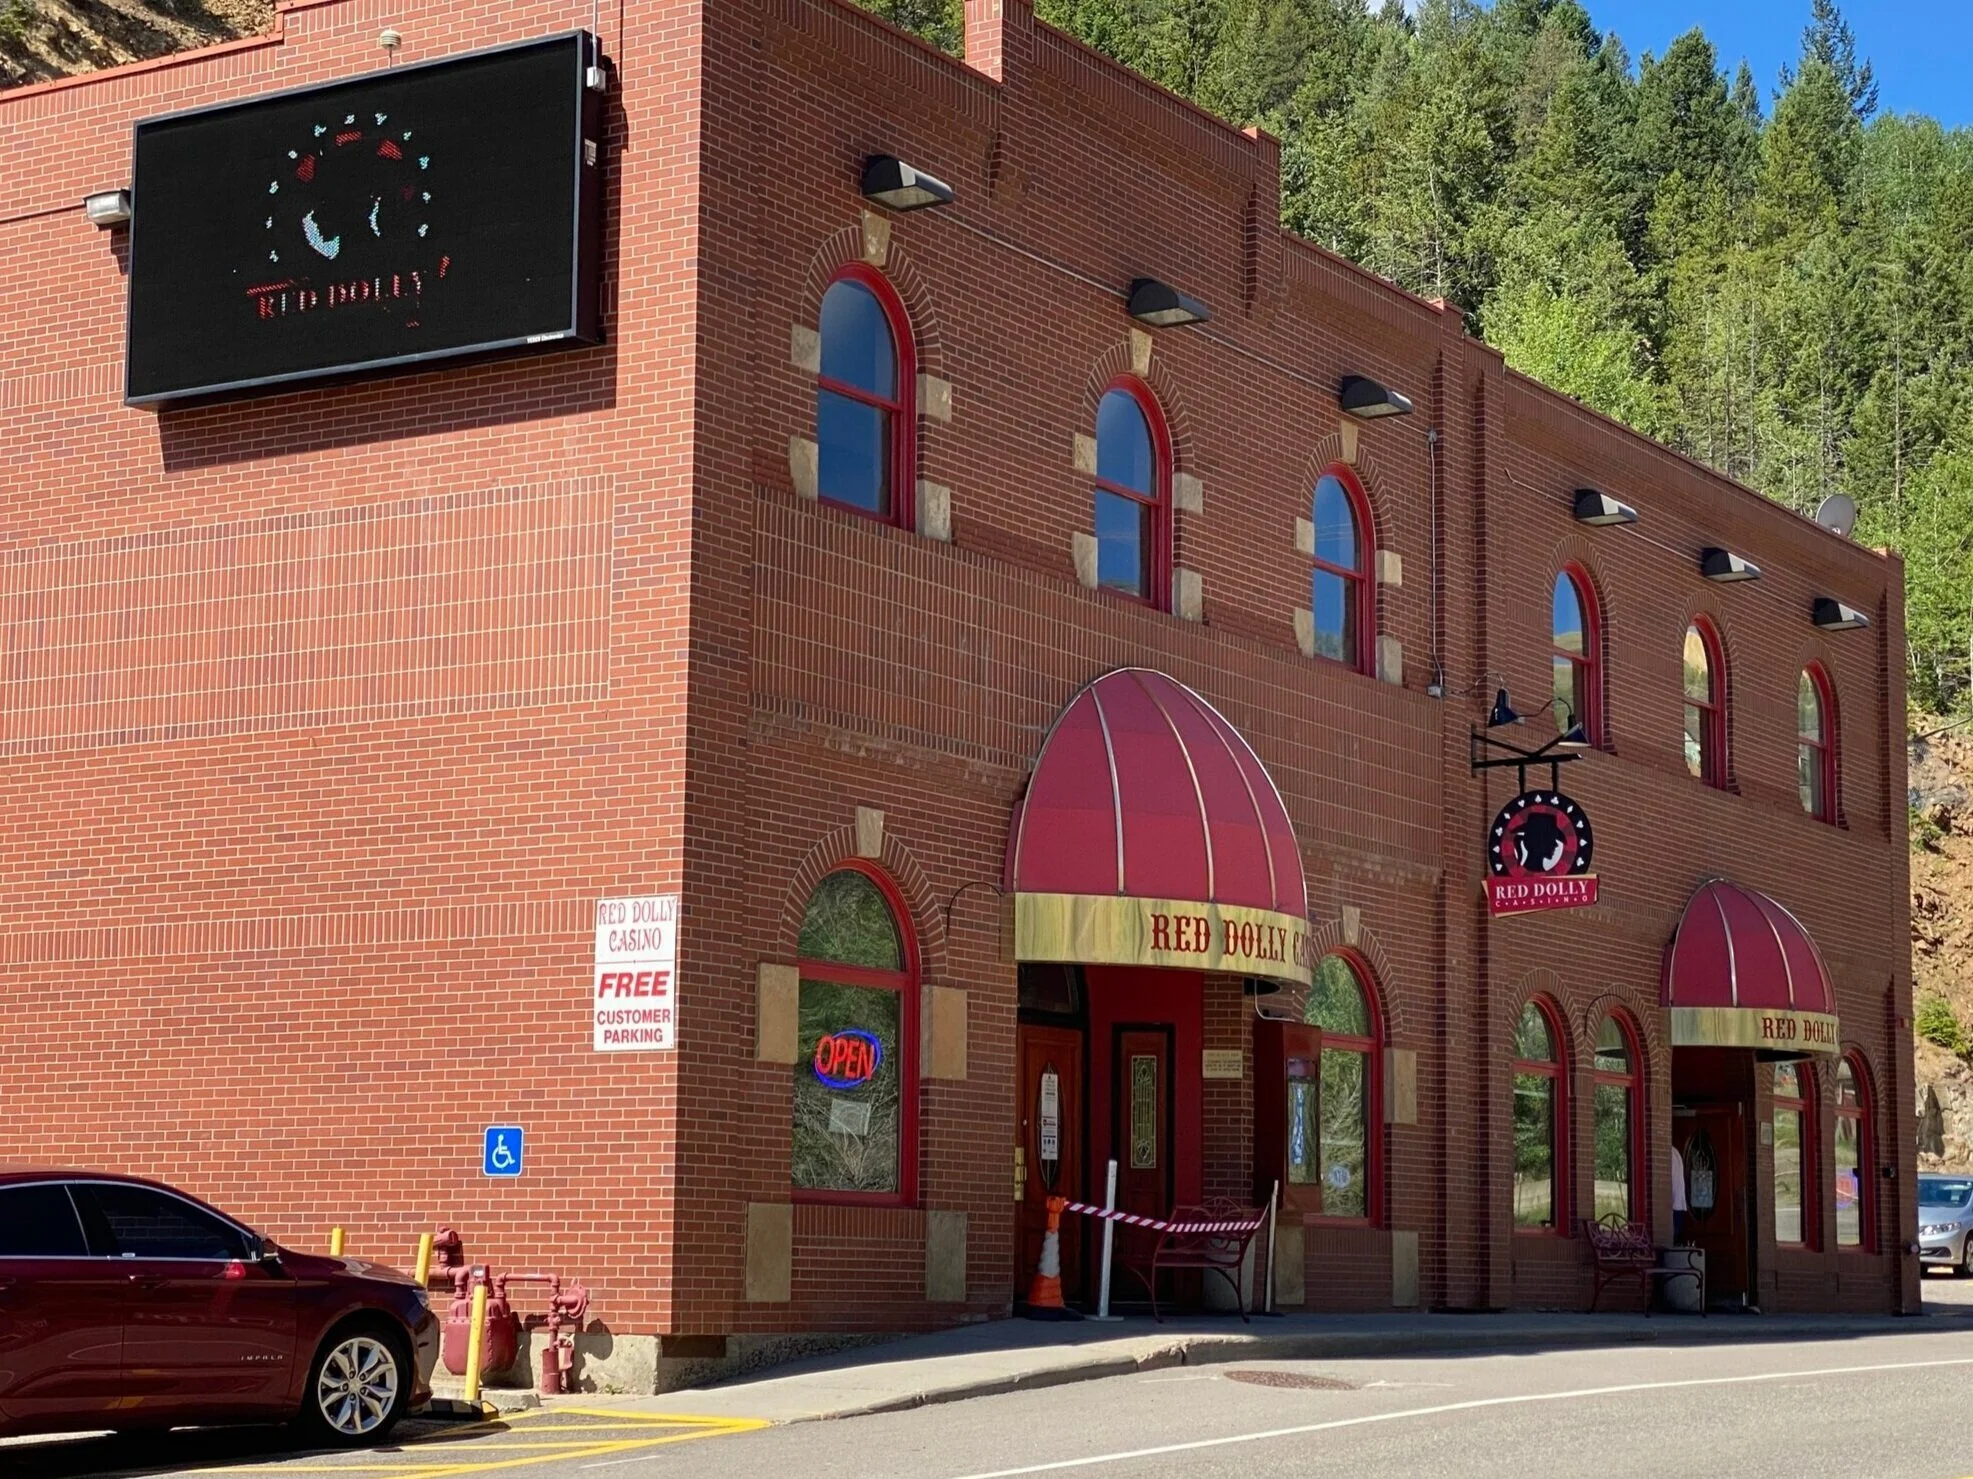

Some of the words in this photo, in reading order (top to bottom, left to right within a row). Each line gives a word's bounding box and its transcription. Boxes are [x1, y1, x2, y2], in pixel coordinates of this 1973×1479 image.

[1496, 884, 1529, 900] RED
[1534, 880, 1588, 897] DOLLY
[599, 902, 626, 925] RED
[632, 898, 677, 923] DOLLY
[608, 927, 661, 952] CASINO
[1151, 913, 1211, 953] RED
[1222, 919, 1287, 963] DOLLY
[598, 970, 670, 998] FREE
[597, 1008, 670, 1025] CUSTOMER
[604, 1028, 663, 1044] PARKING
[1762, 1017, 1796, 1041] RED
[1803, 1020, 1836, 1045] DOLLY
[816, 1034, 875, 1081] OPEN
